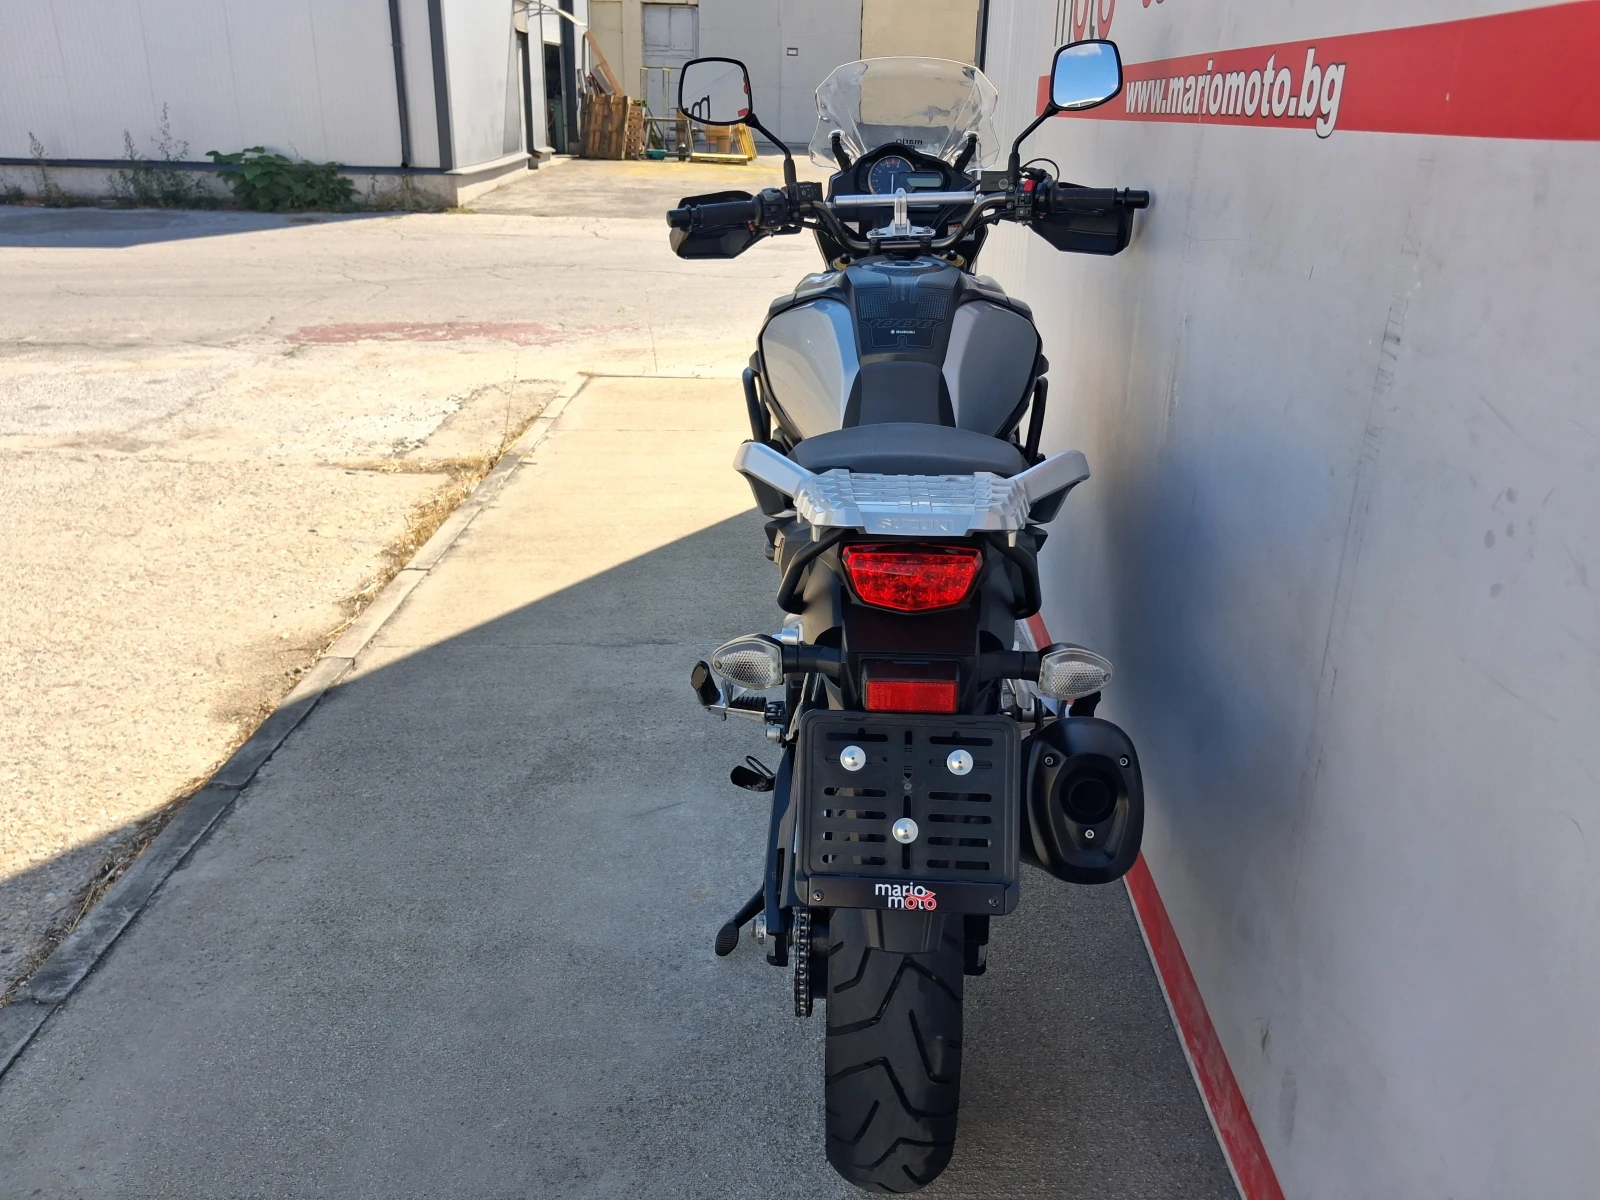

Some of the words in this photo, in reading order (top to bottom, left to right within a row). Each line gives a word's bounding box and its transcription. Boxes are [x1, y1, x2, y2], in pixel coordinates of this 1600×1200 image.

[1125, 47, 1346, 139] www.mariomoto.bg
[878, 518, 953, 532] SUZUKI
[874, 881, 926, 897] mario
[887, 896, 937, 911] moto
